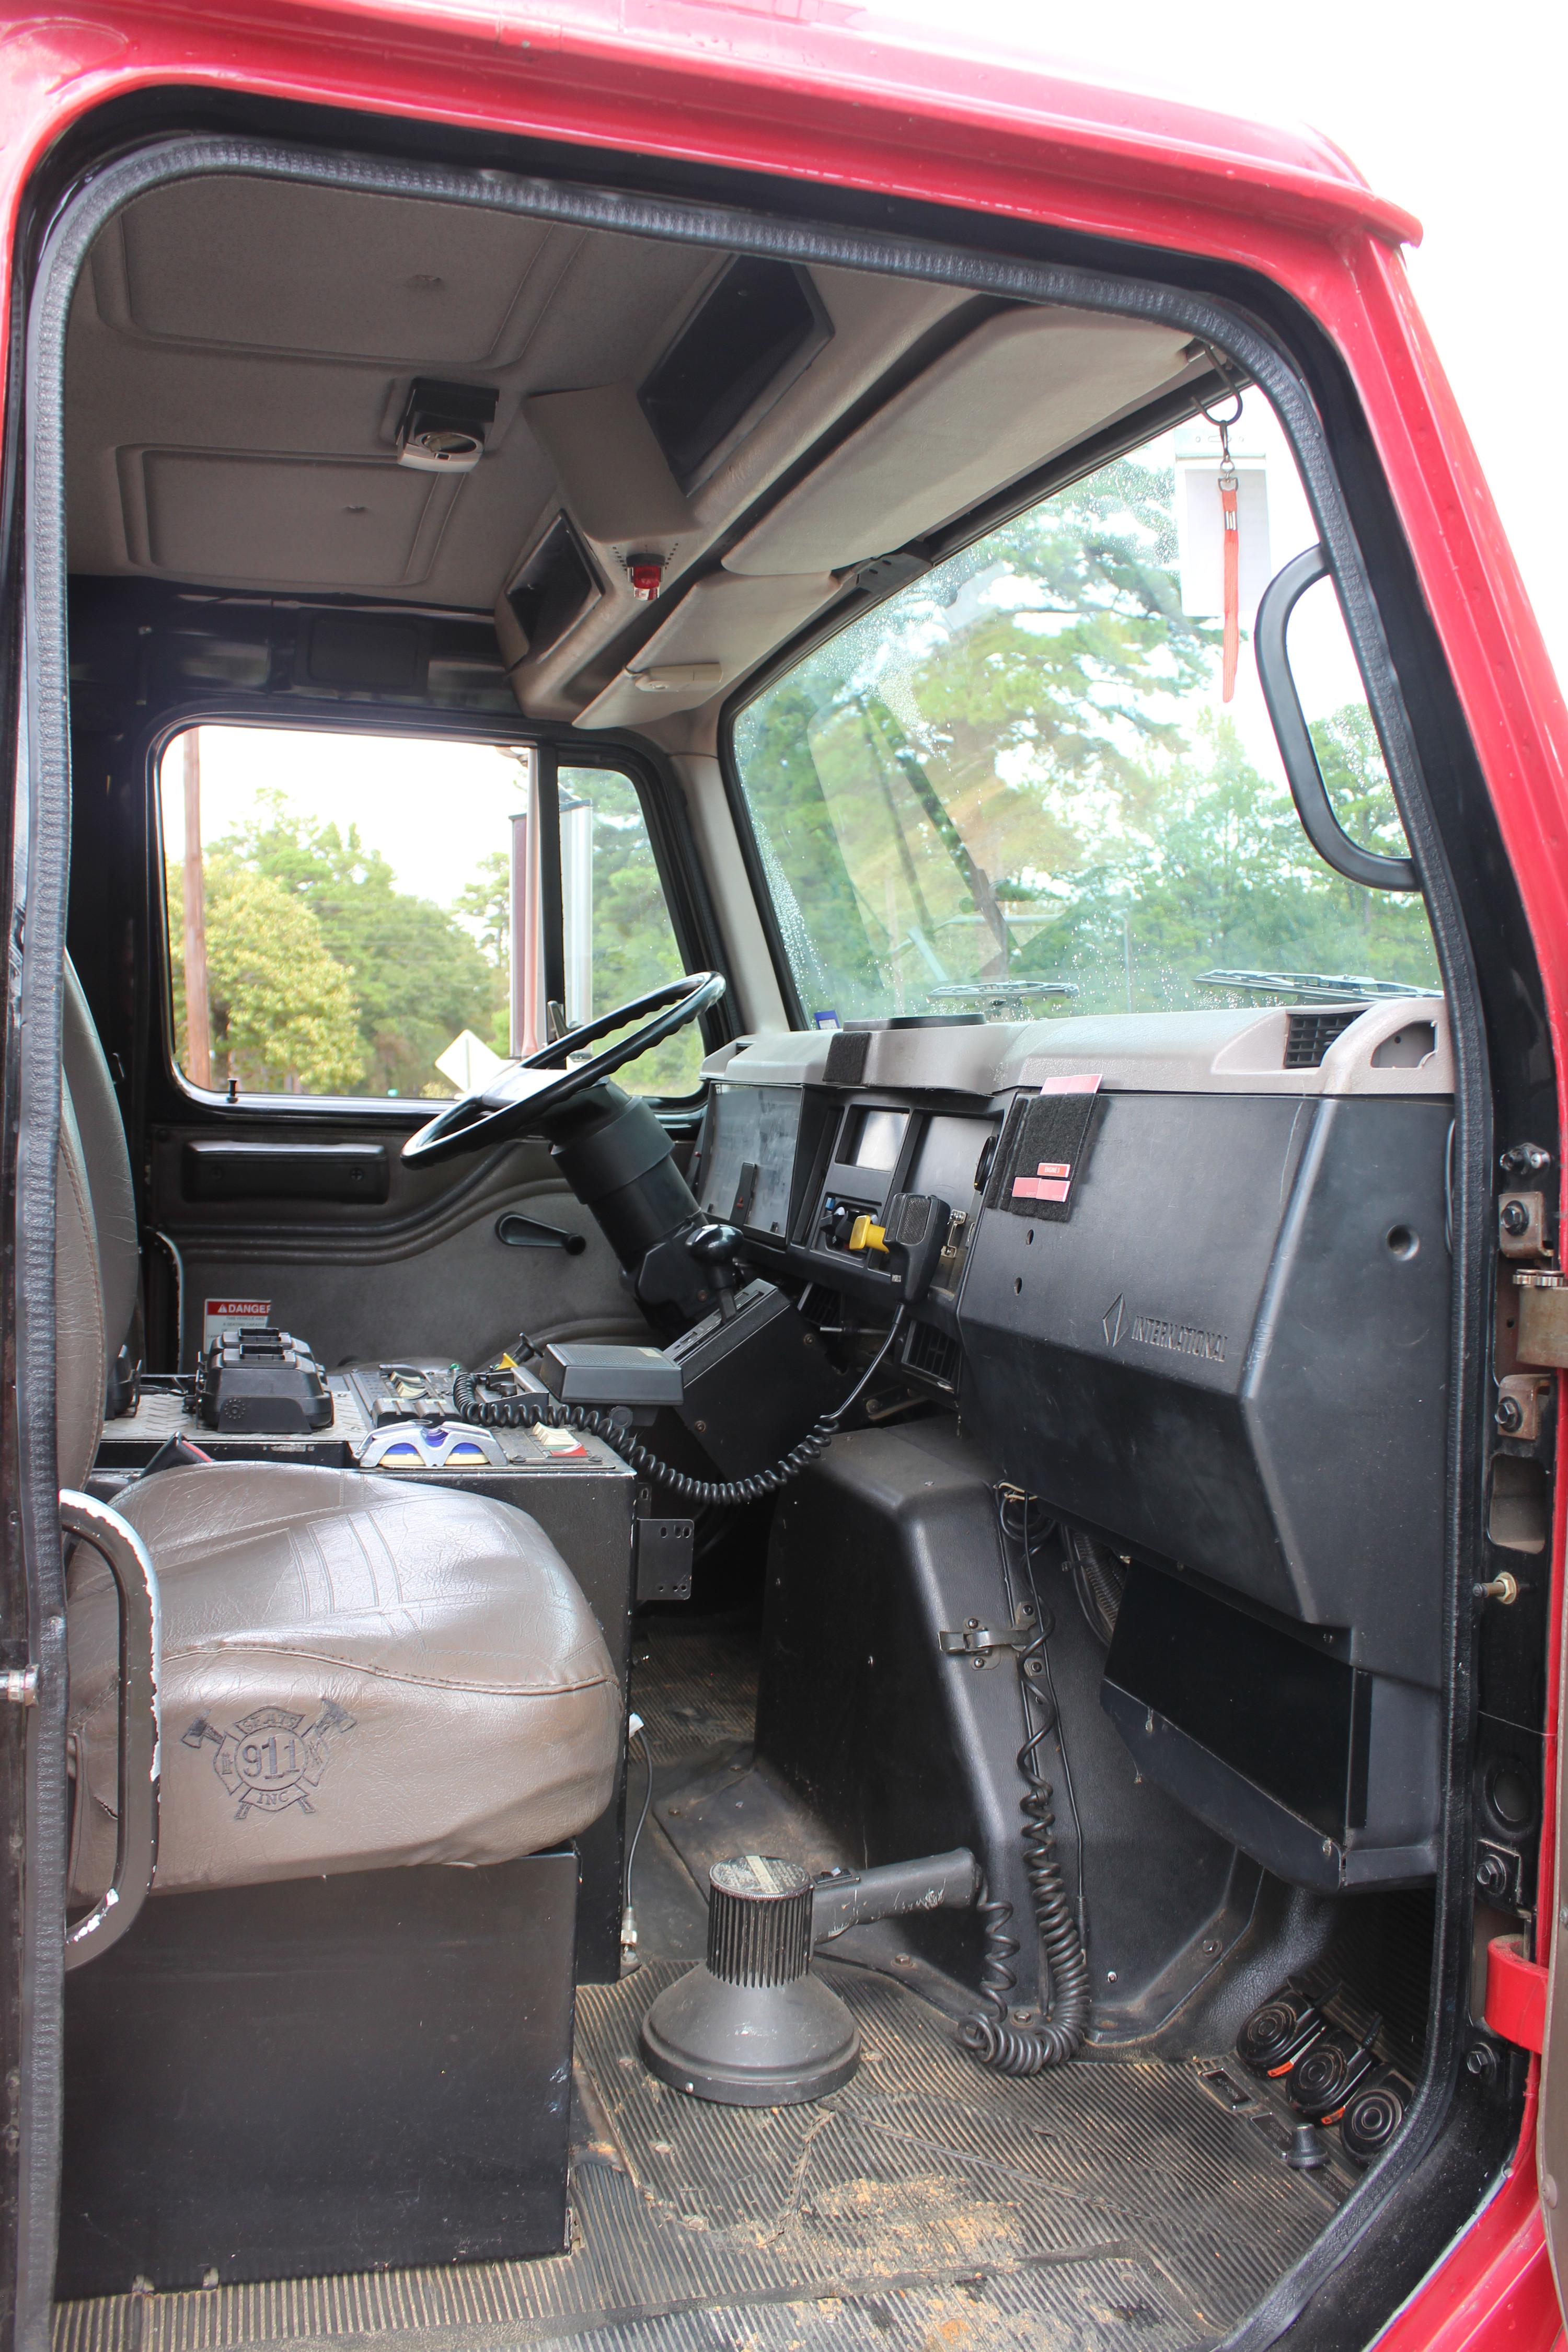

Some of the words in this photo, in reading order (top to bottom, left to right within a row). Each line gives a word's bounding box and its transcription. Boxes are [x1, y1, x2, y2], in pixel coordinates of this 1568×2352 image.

[1131, 1315, 1228, 1362] INTERNATIONAL
[242, 1736, 301, 1780] 911
[257, 1791, 290, 1805] INC
